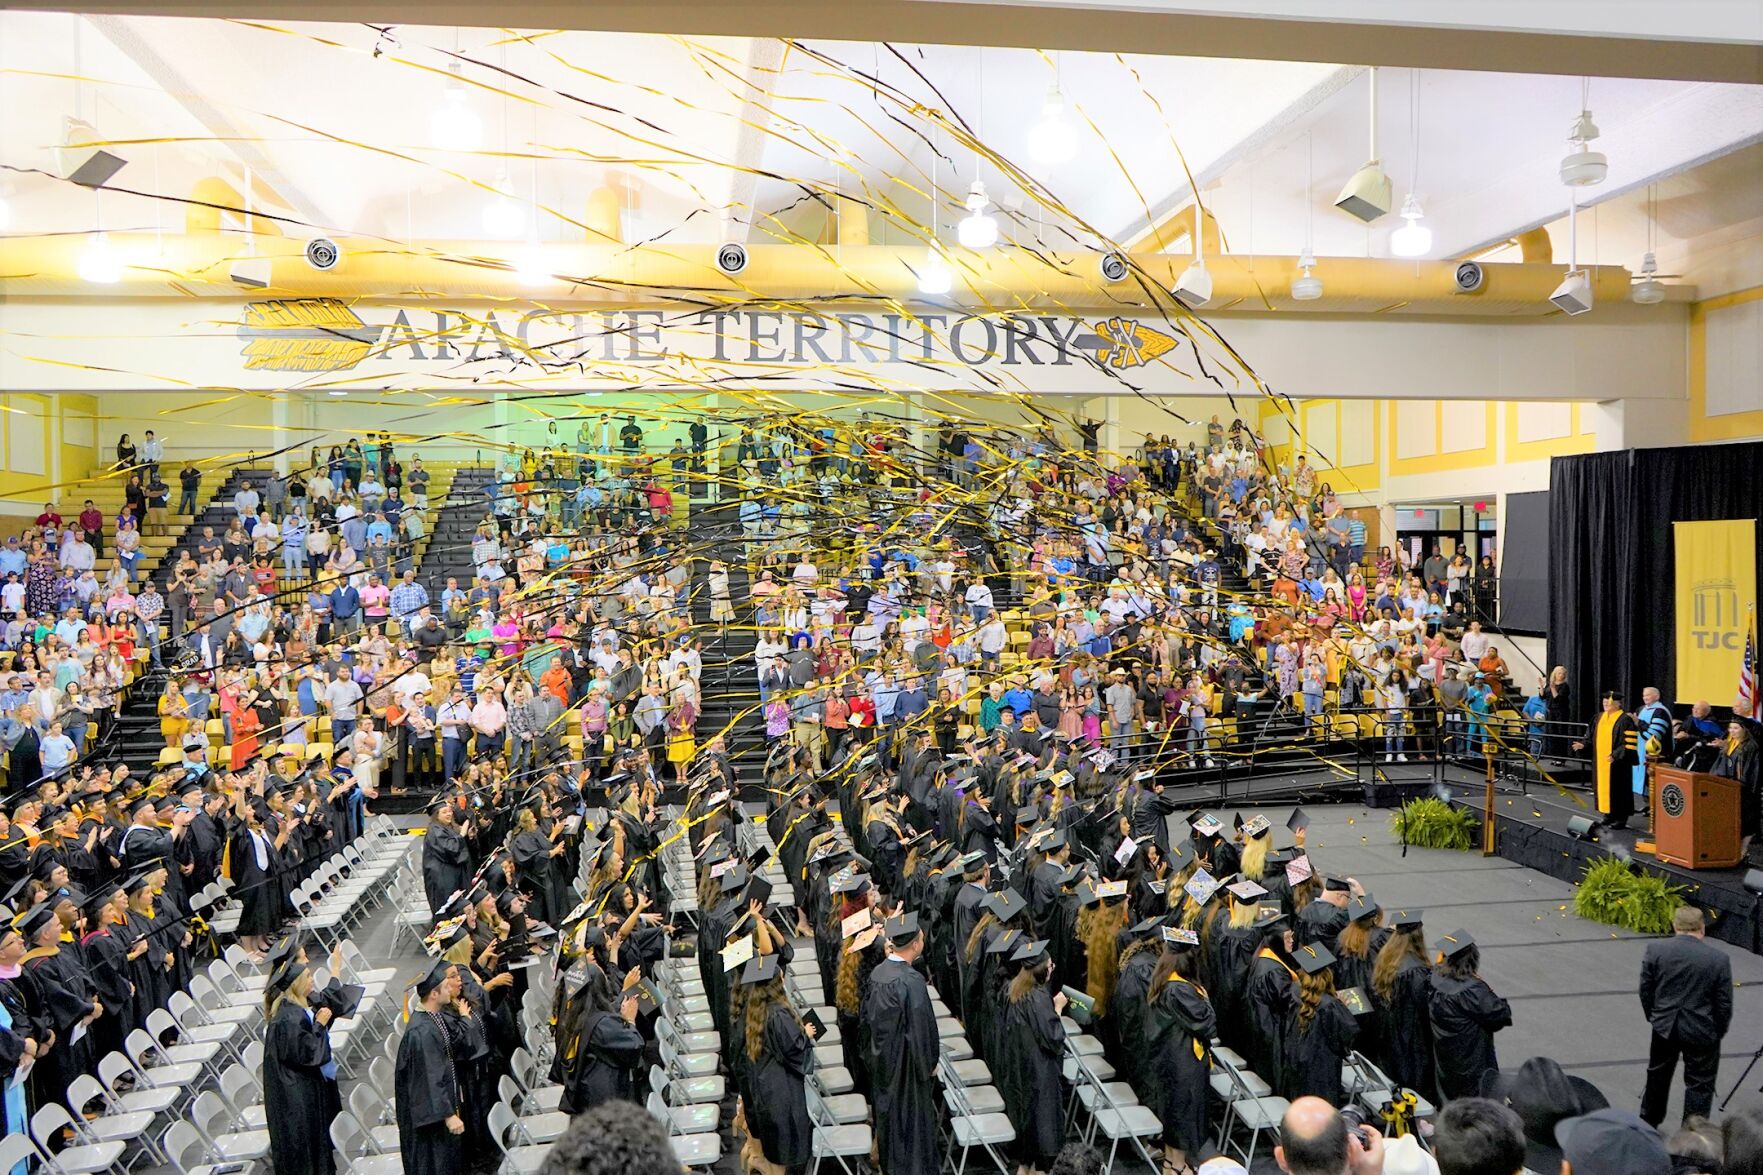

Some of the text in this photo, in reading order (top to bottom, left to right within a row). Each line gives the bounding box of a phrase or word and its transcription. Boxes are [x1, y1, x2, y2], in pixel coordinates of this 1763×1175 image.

[700, 311, 1084, 366] TERRITORY
[1691, 631, 1740, 650] TJC
[181, 655, 199, 667] GRAD
